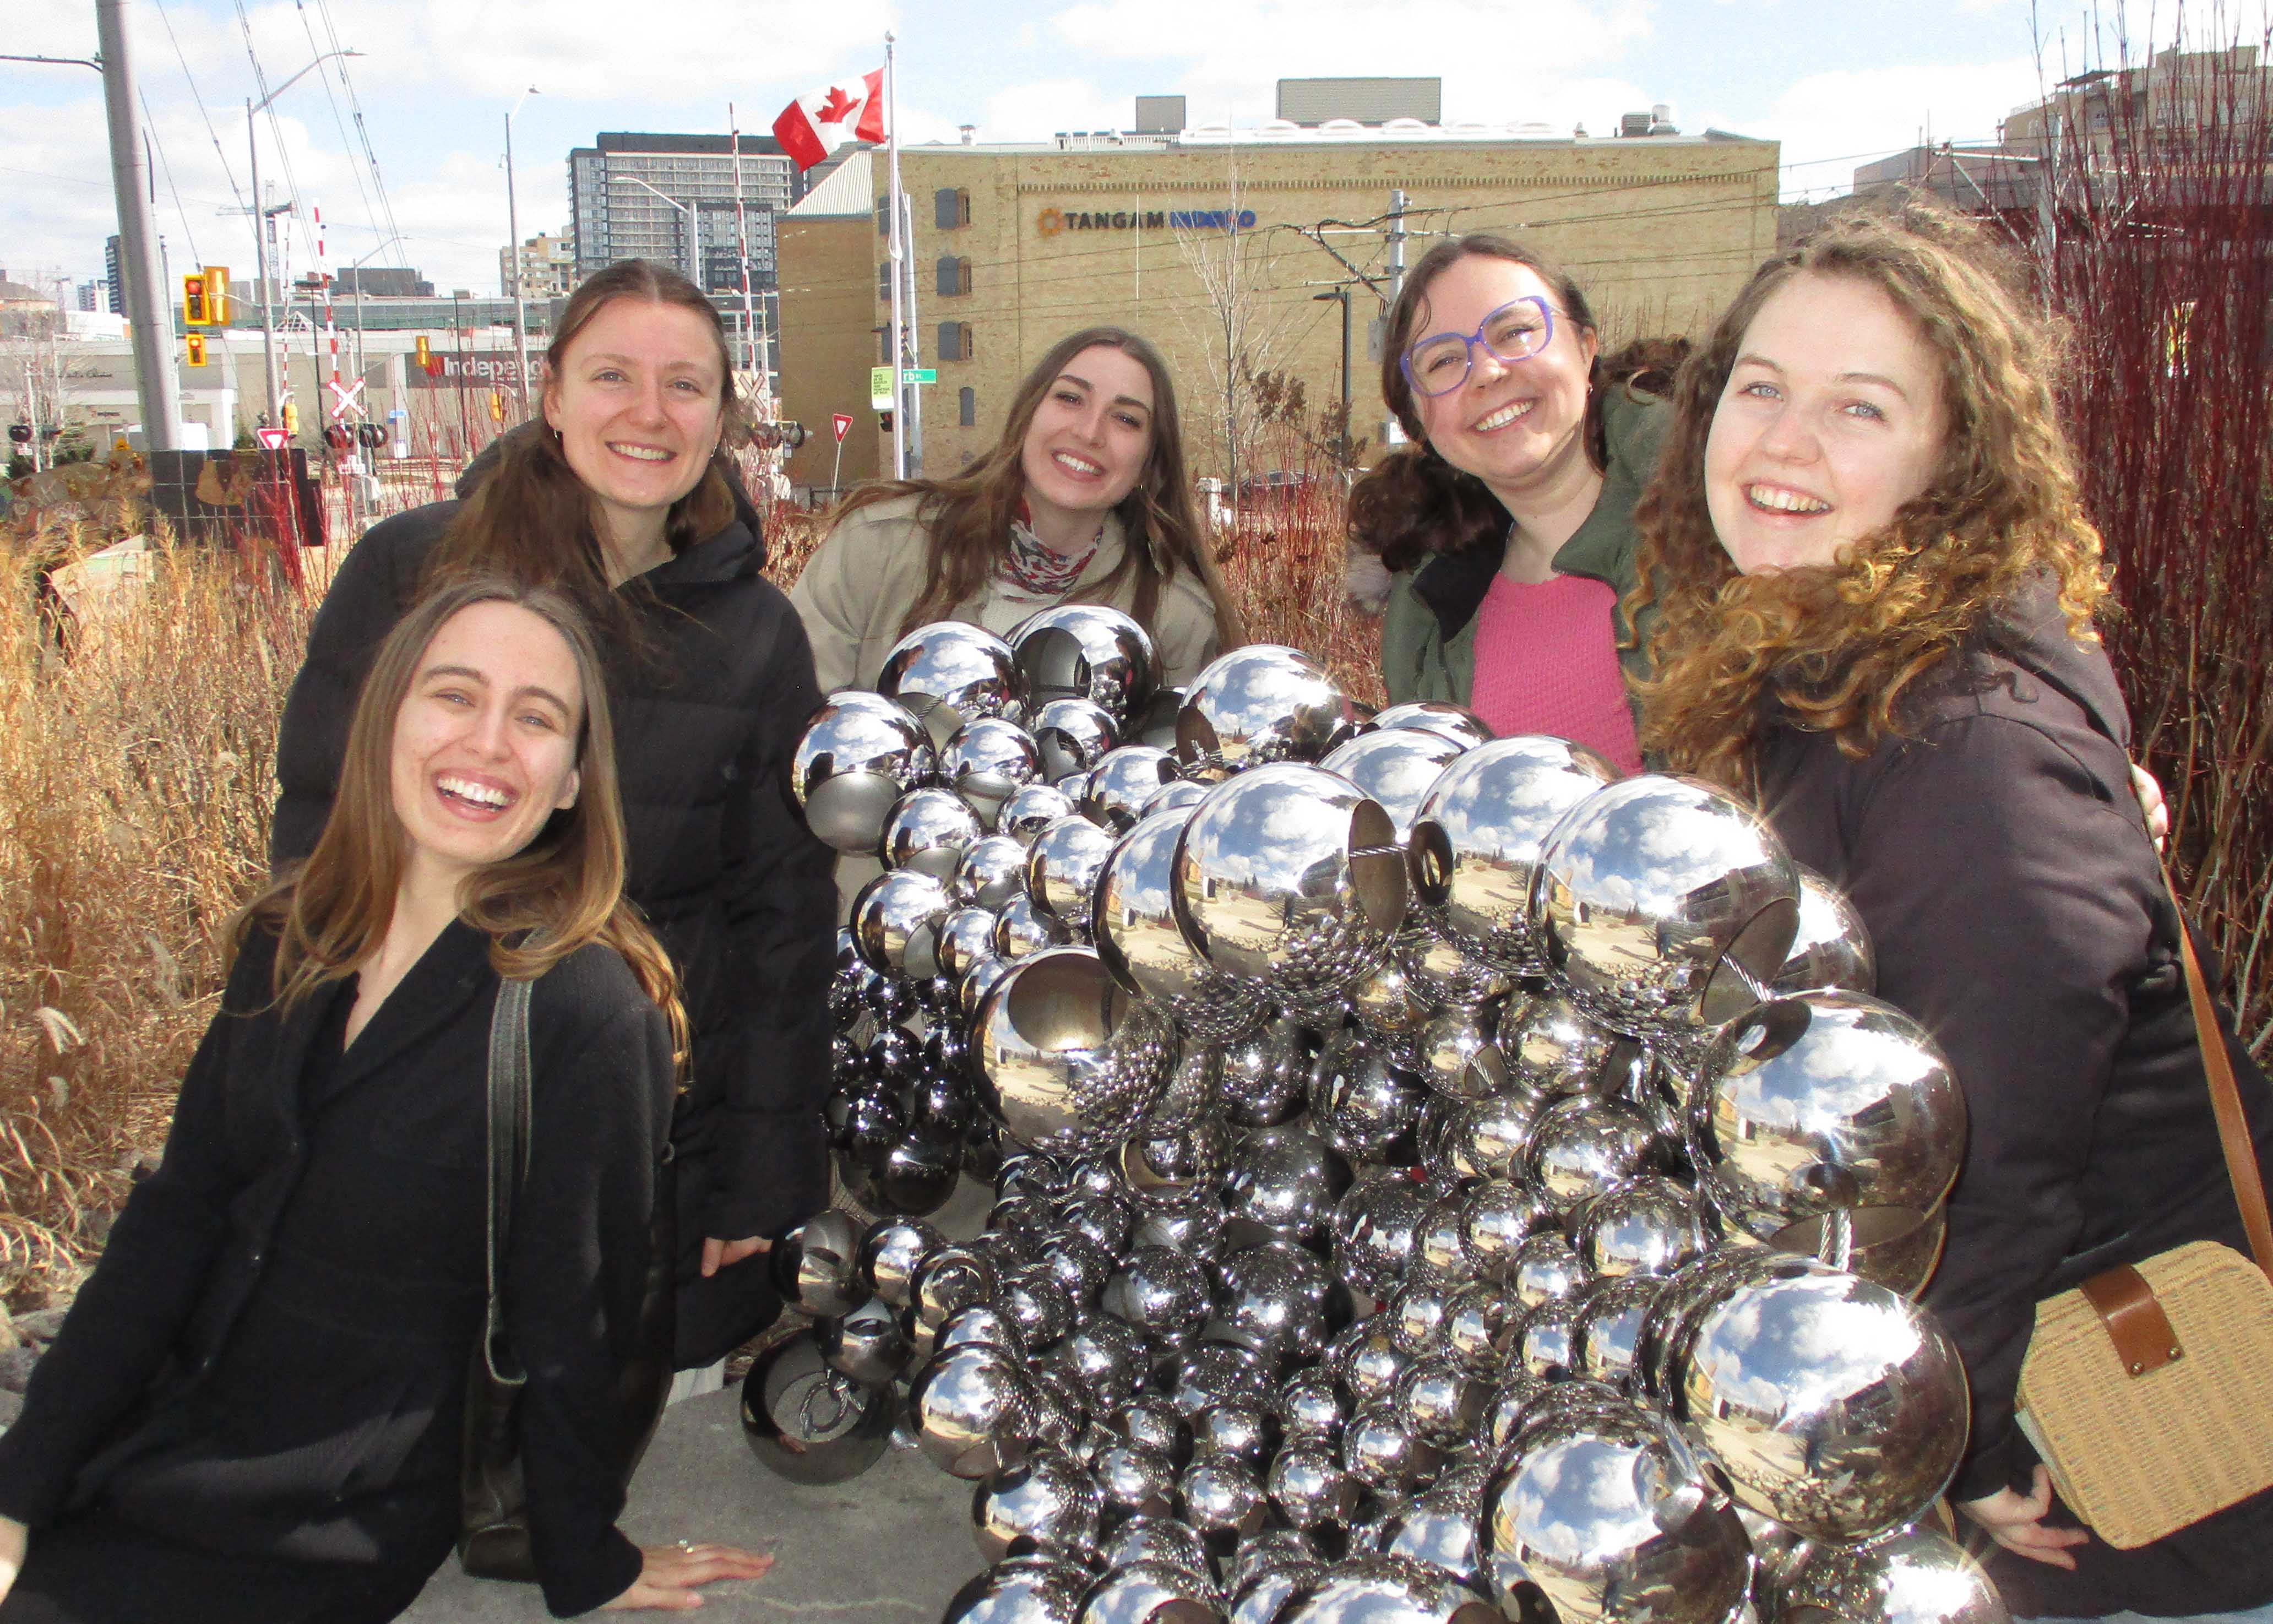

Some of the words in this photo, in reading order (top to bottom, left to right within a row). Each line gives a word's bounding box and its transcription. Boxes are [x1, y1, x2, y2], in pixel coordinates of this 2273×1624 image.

[1065, 212, 1165, 229] TANGAM
[443, 356, 544, 381] Indeped
[902, 371, 915, 381] rb
